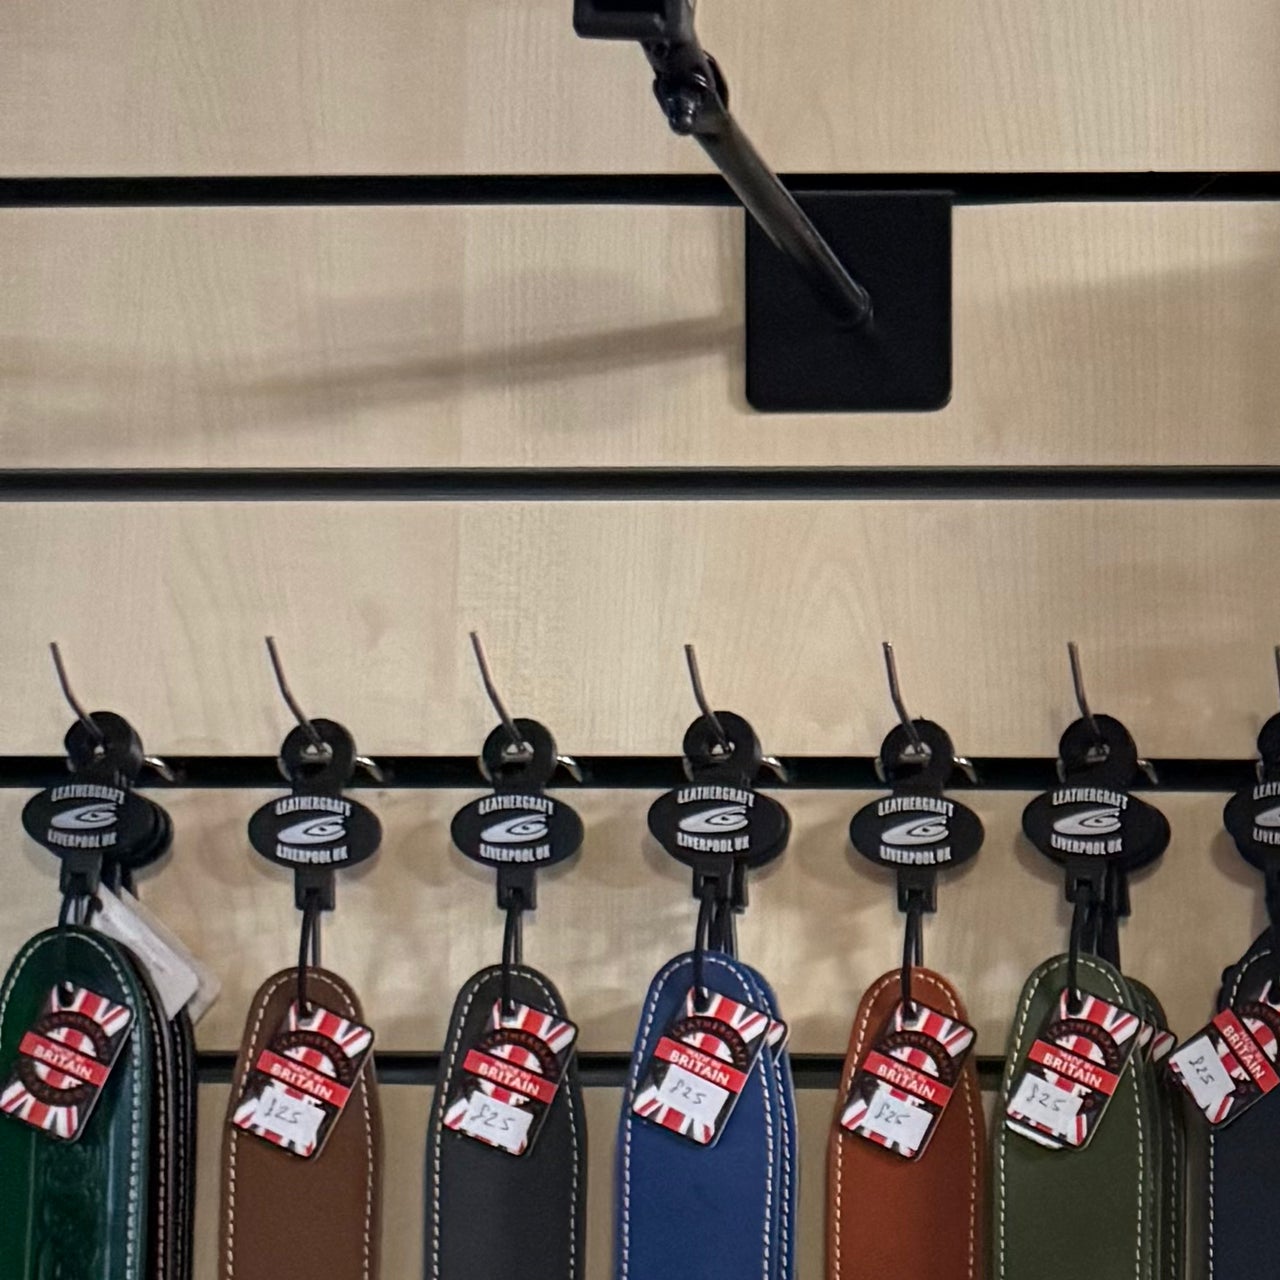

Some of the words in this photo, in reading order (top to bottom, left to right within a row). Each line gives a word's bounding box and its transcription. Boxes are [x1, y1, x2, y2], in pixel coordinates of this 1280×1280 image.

[275, 843, 332, 864] LIVERPOOL
[479, 843, 535, 862] LIVERPOOL
[676, 832, 733, 853] LIVERPOOL
[880, 845, 936, 865] LIVERPOOL
[1051, 833, 1106, 855] LIVERPOOL
[33, 1045, 93, 1081] BRITAIN
[669, 1049, 730, 1086] BRITAIN
[1042, 1052, 1103, 1088] BRITAIN
[1222, 1025, 1266, 1080] BRITAIN
[270, 1063, 333, 1099] BRITAIN
[478, 1062, 540, 1097] BRITAIN
[877, 1064, 935, 1099] BRITAIN
